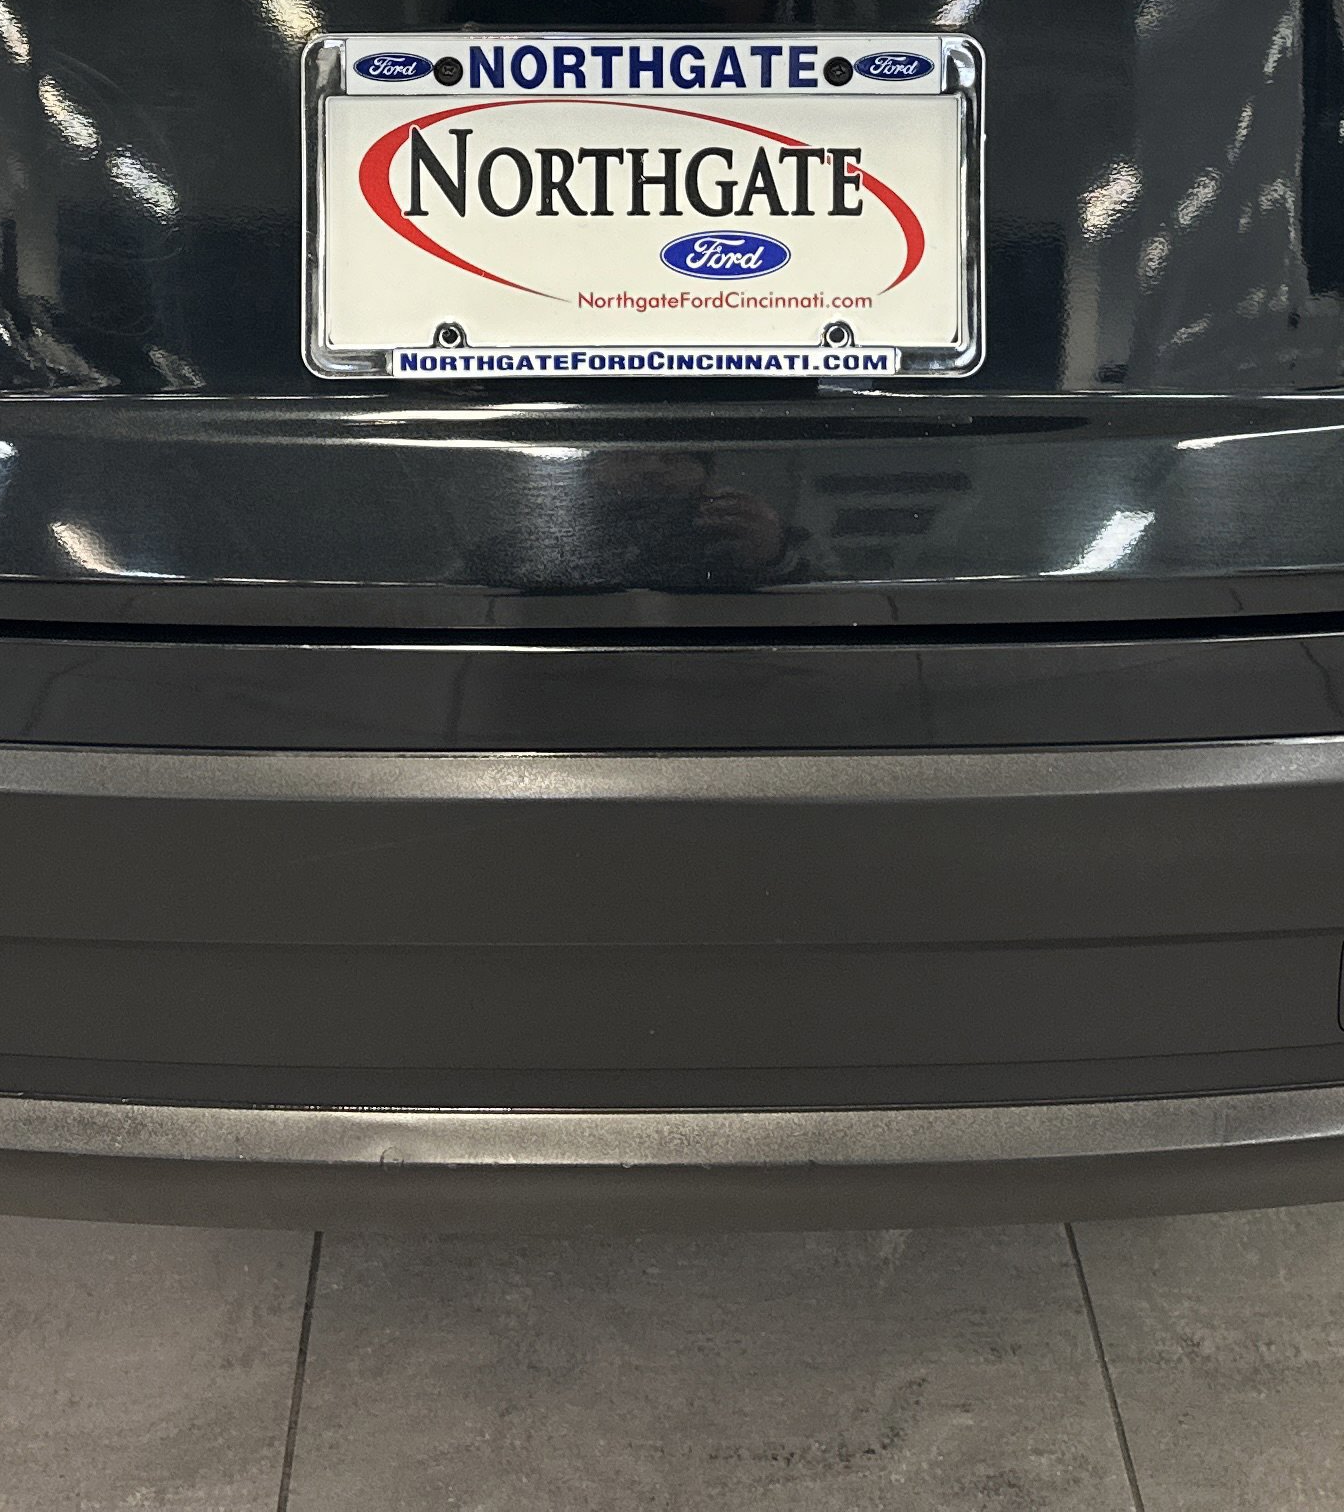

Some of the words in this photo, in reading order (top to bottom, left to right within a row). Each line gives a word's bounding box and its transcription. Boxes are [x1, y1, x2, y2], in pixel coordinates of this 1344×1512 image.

[368, 56, 417, 76] Ford
[469, 44, 818, 90] NORTHGATE
[869, 55, 918, 76] Ford
[403, 127, 864, 219] NORTHGATE
[685, 236, 765, 270] Ford
[577, 290, 873, 313] NorthgateFordCincinnati.com
